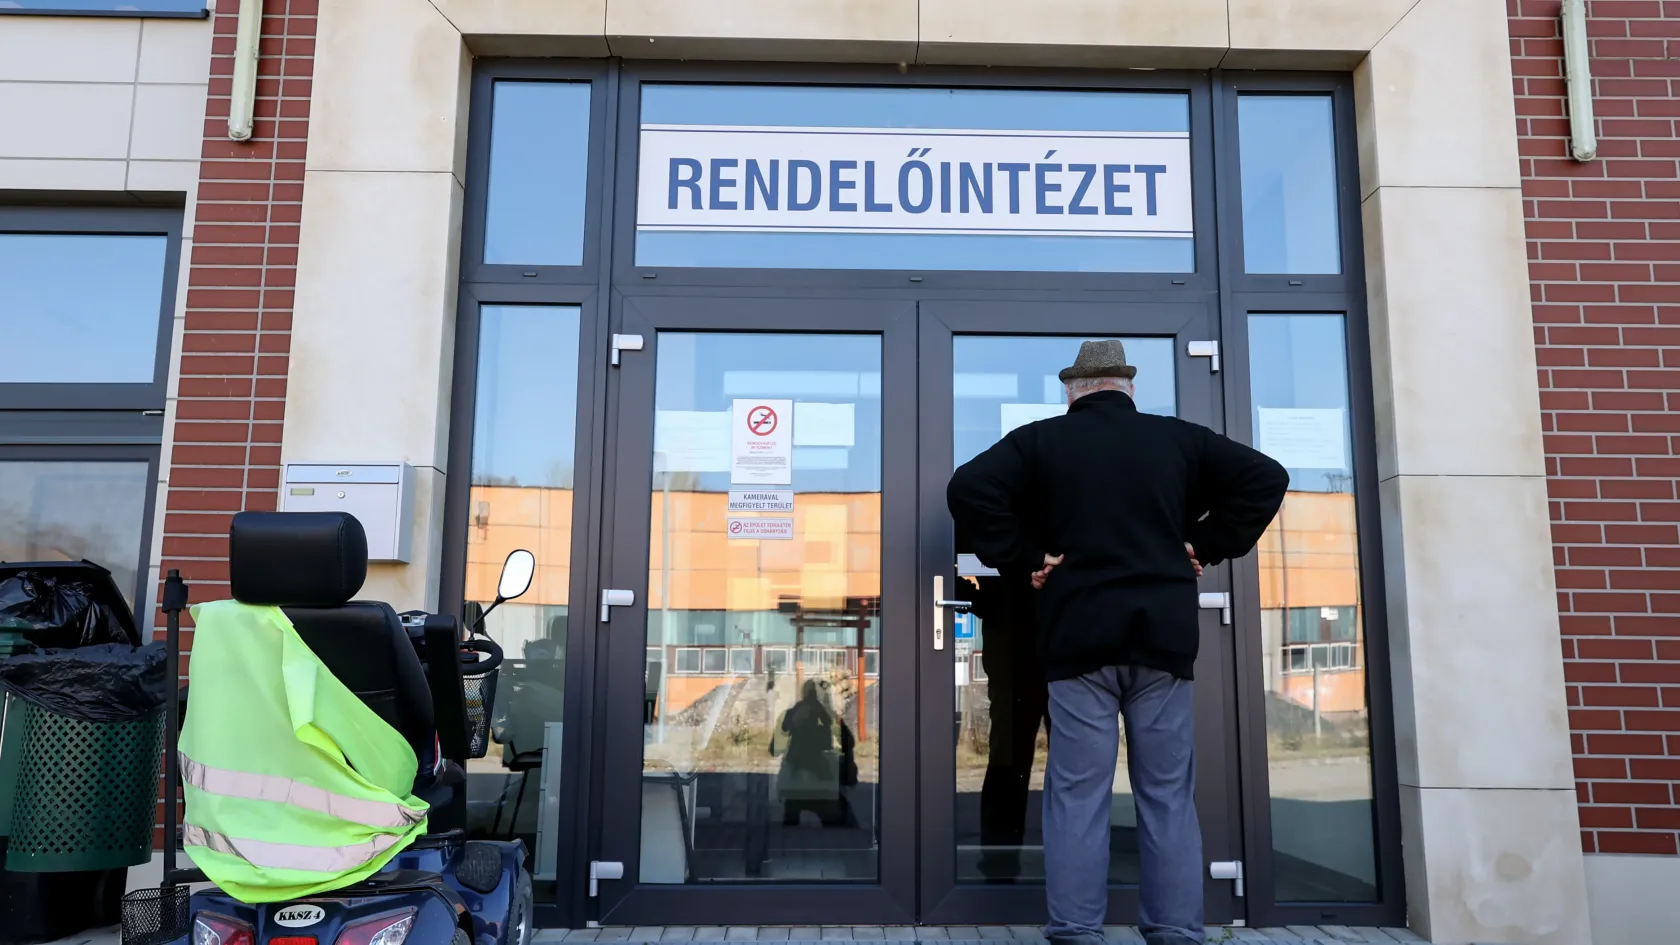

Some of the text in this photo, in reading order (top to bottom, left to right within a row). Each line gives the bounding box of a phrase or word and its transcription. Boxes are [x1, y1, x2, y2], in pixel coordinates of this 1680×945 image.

[666, 147, 1168, 217] RENDELŐINTÉZET
[278, 910, 322, 921] KKSZ 4
